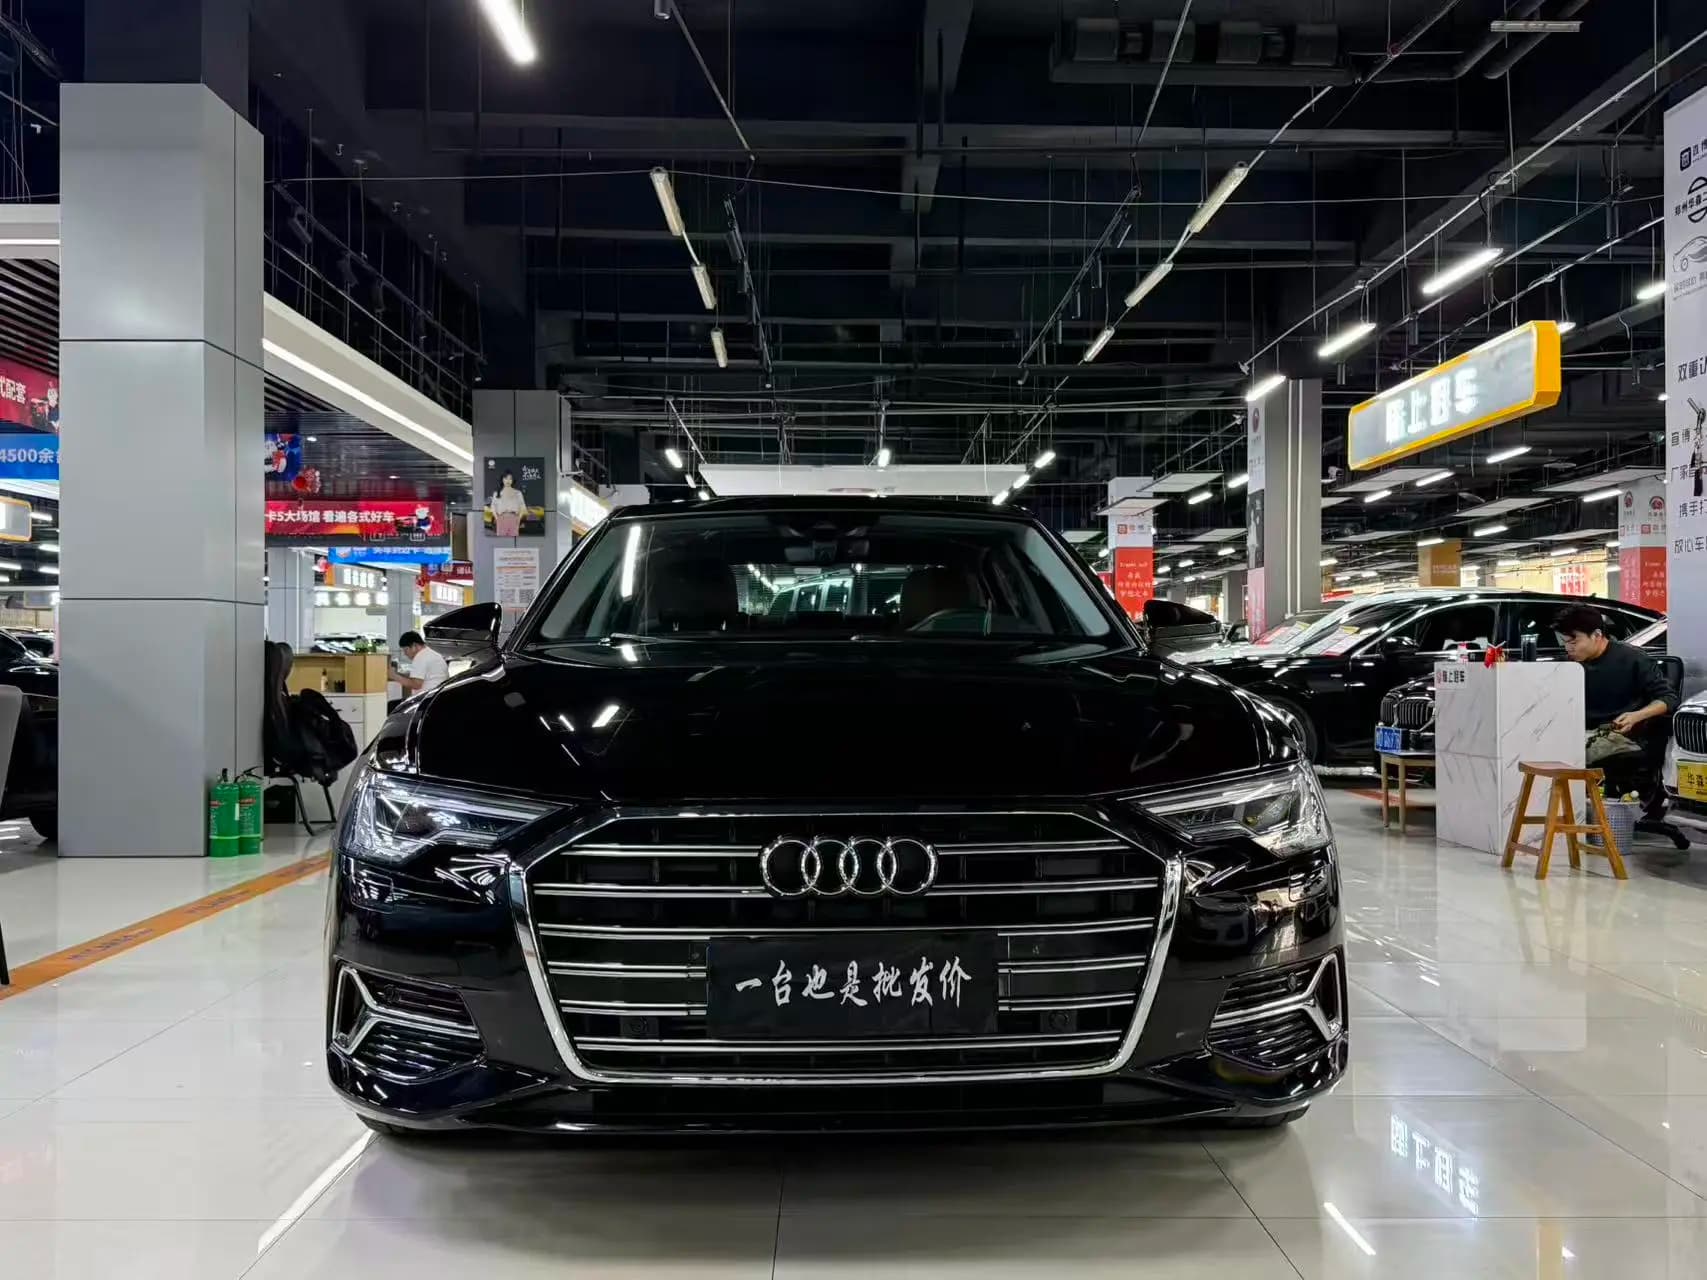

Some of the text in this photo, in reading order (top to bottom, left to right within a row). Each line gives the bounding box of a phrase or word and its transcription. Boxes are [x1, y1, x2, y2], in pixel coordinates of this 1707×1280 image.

[1674, 536, 1707, 554] 放心车
[735, 956, 972, 1008] 一台也是批发价
